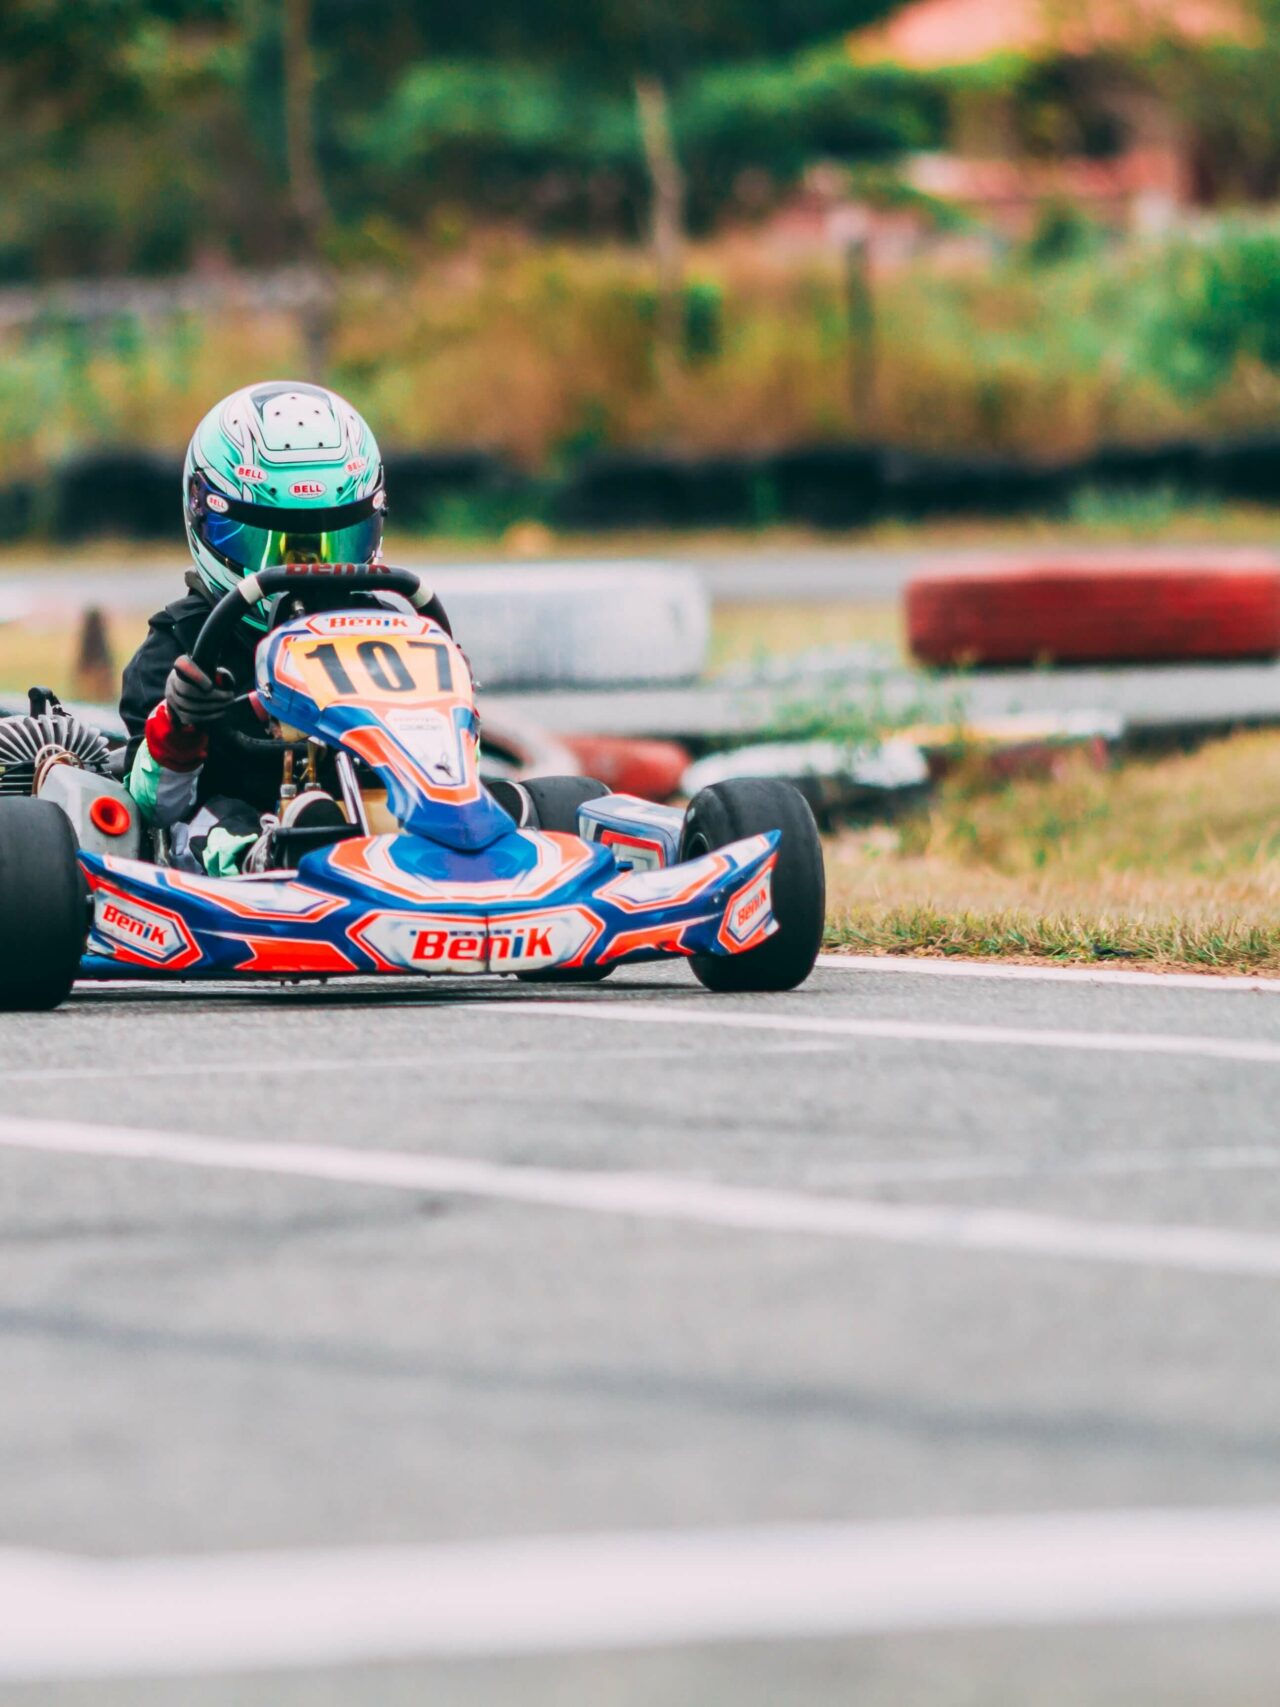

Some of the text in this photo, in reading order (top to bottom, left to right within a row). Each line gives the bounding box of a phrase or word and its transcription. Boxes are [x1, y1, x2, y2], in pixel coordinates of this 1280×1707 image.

[238, 467, 263, 480] BELL
[293, 484, 322, 494] BELL
[304, 640, 454, 695] 107
